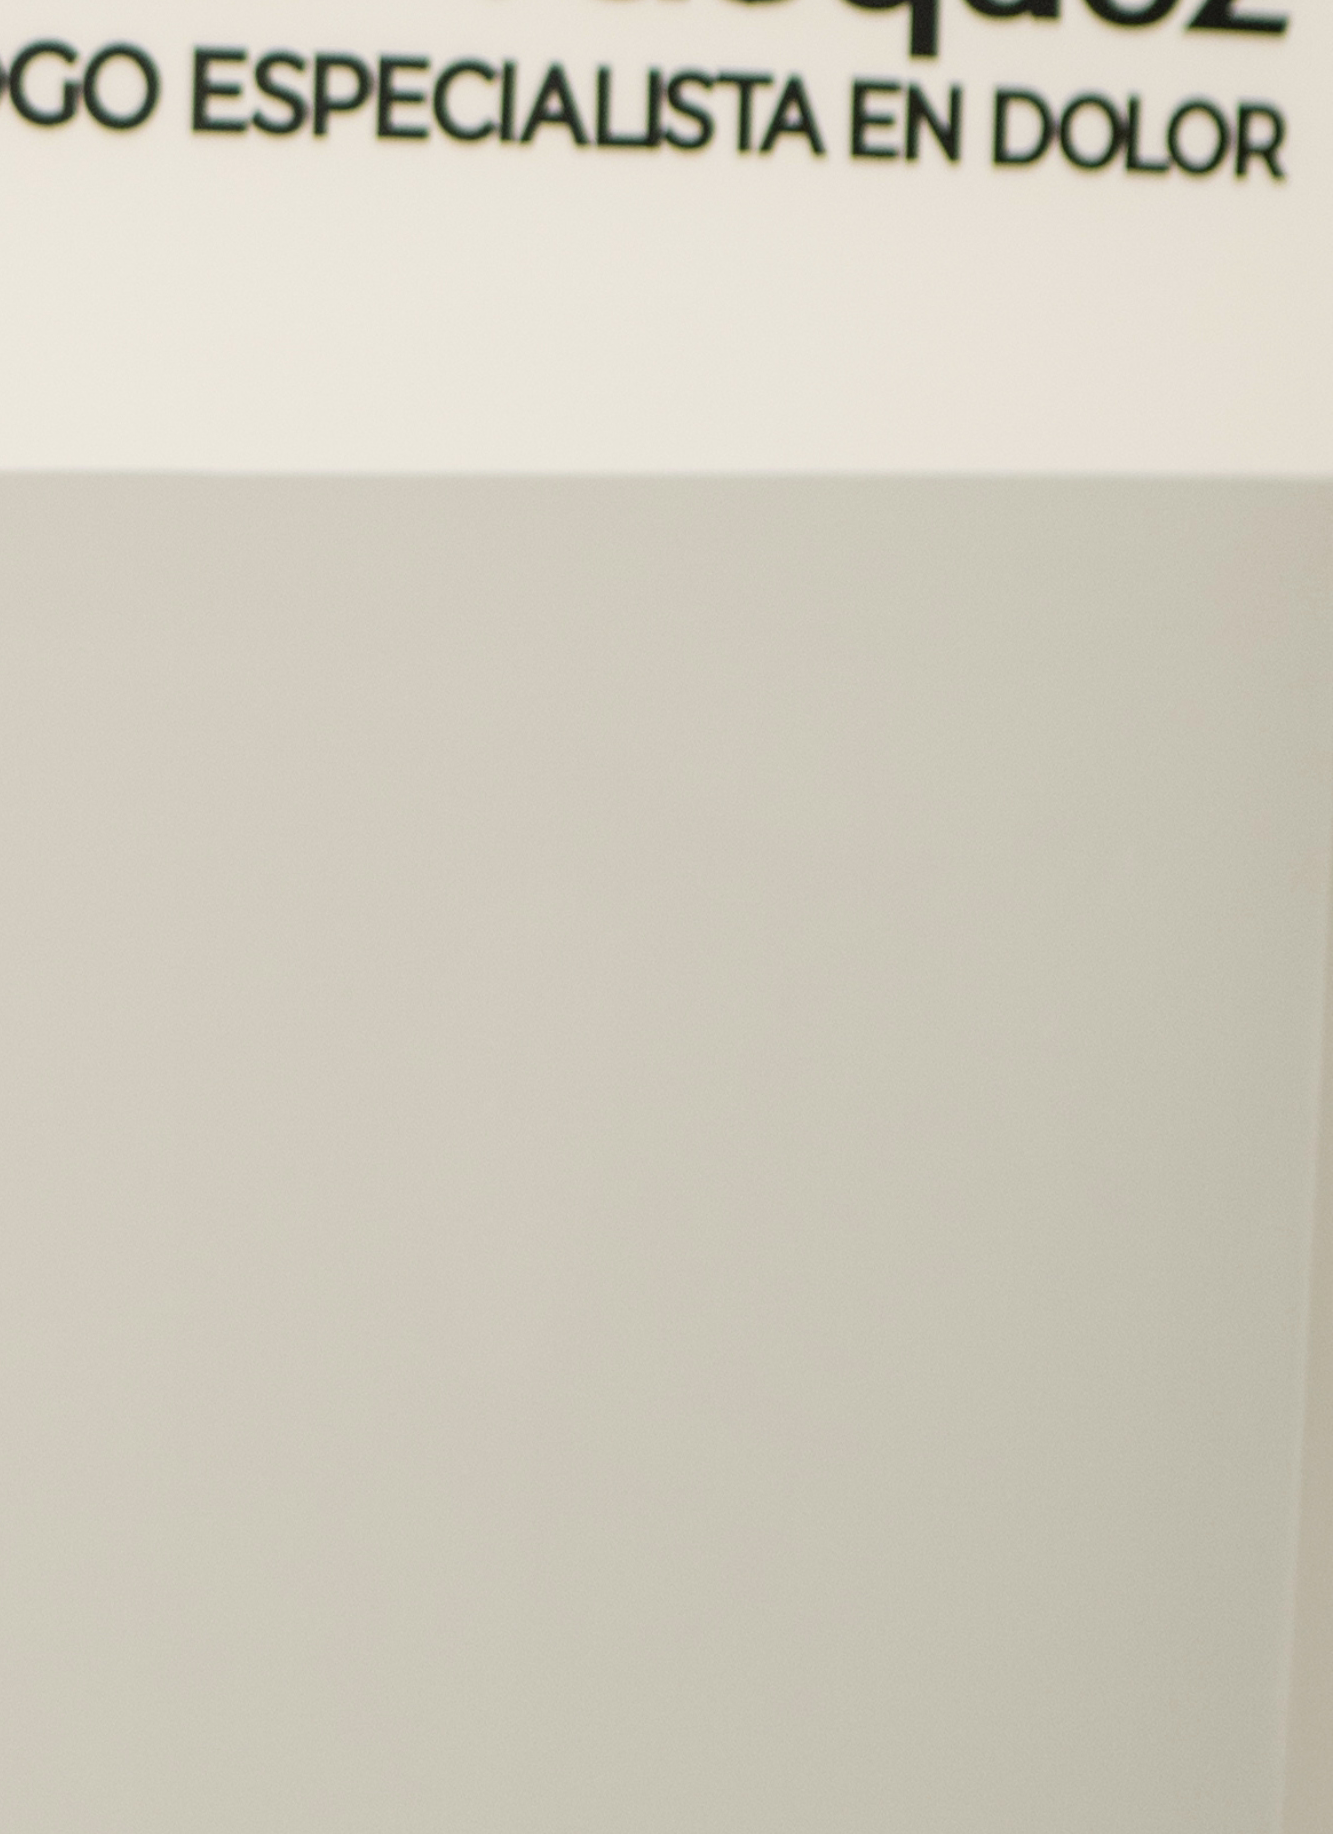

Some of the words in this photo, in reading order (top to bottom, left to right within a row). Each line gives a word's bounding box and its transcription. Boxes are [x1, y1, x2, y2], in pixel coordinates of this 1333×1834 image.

[189, 45, 828, 159] ESPECIALISTA
[848, 77, 965, 165] EN
[990, 86, 1289, 184] DOLOR
